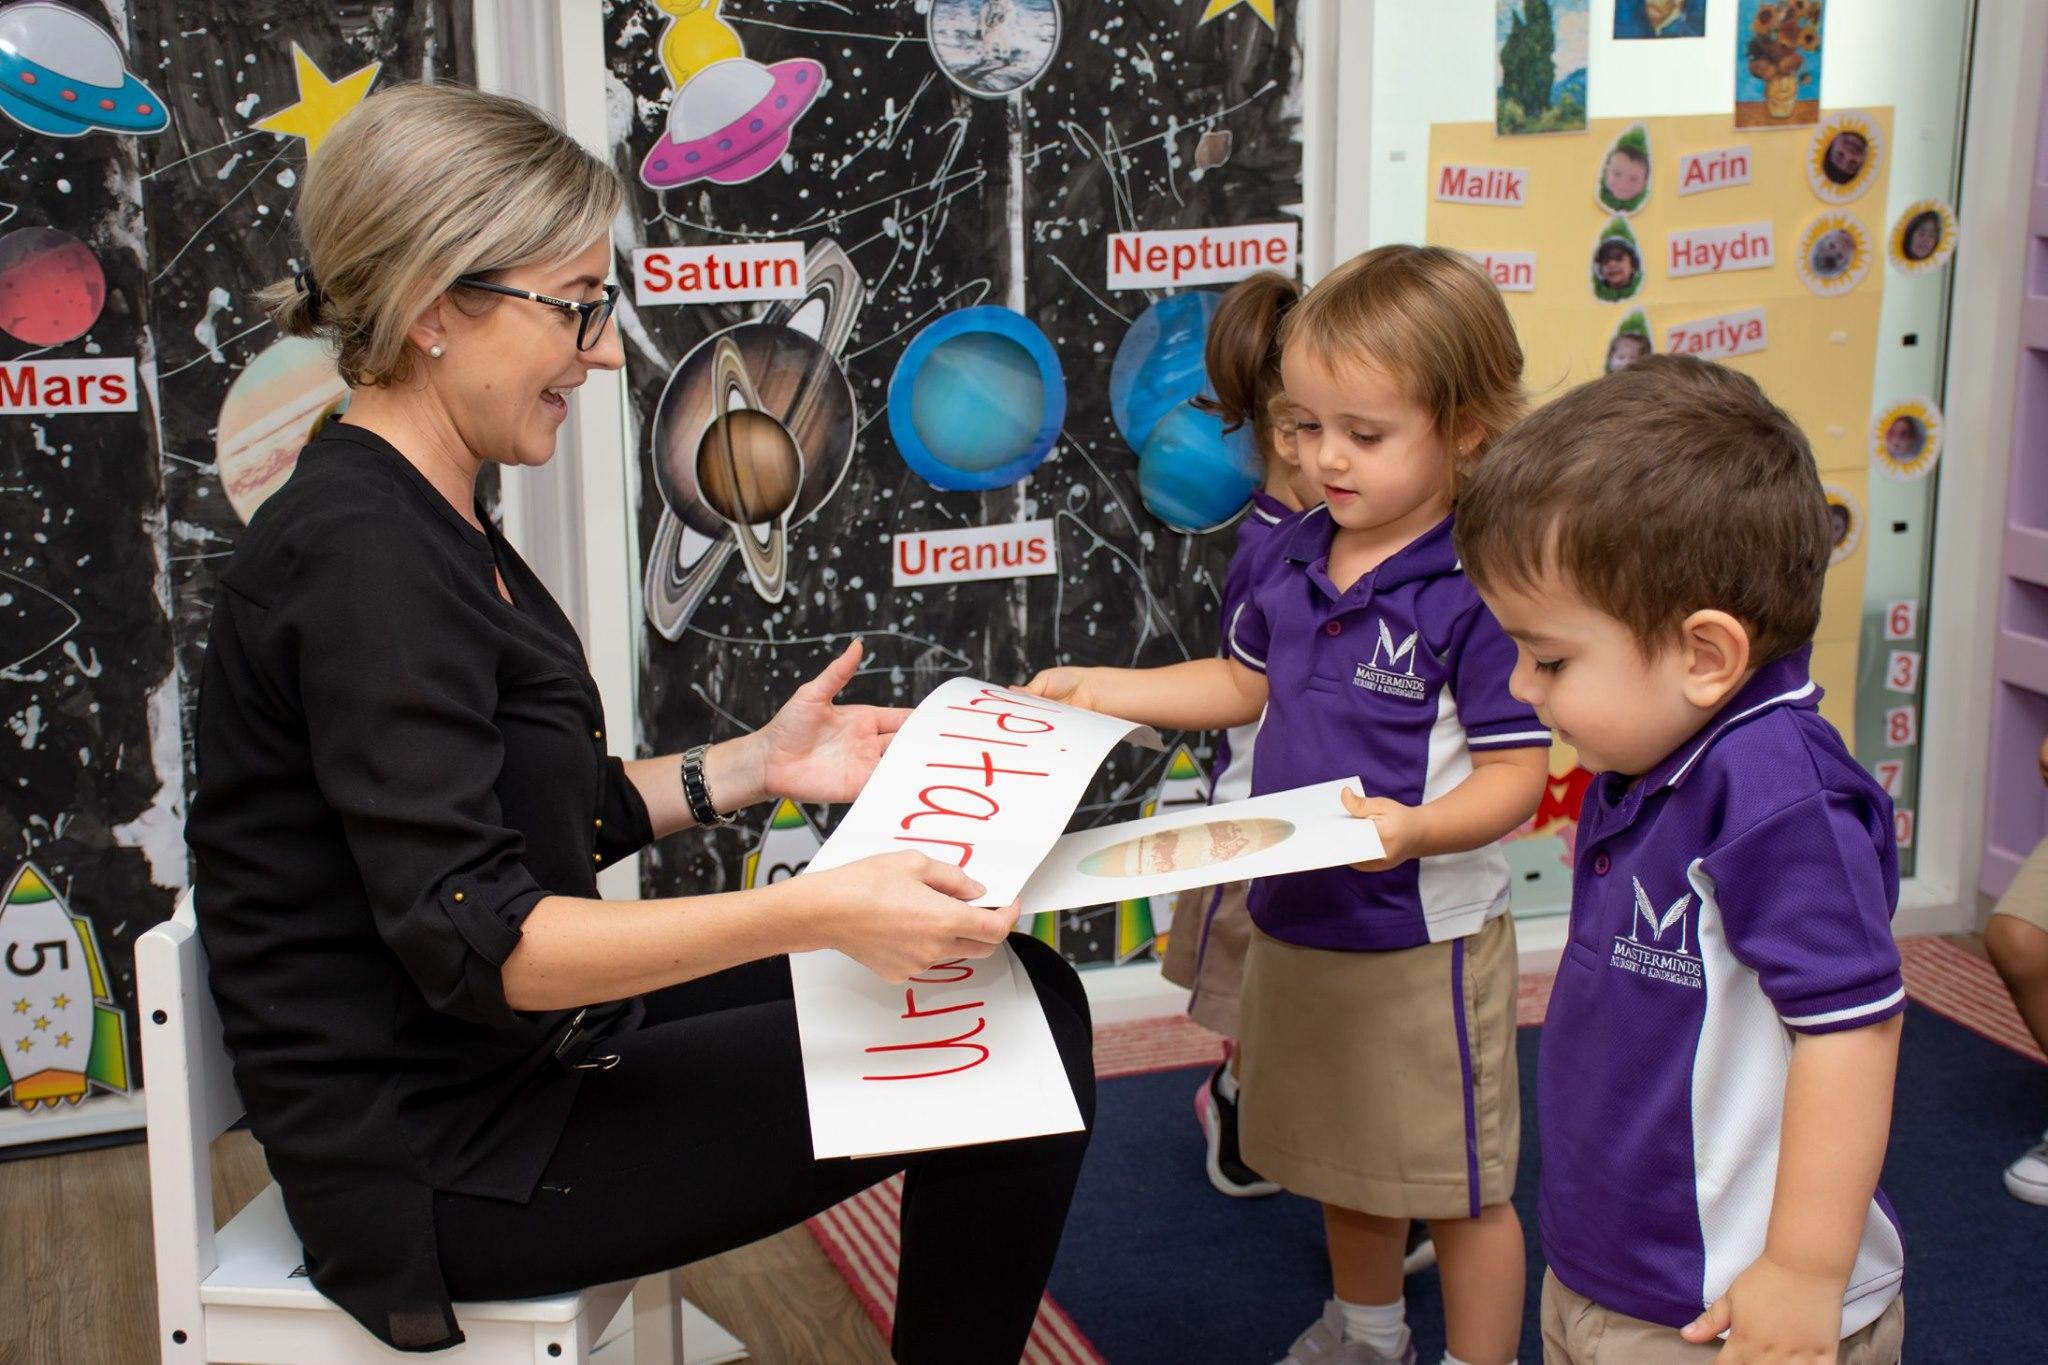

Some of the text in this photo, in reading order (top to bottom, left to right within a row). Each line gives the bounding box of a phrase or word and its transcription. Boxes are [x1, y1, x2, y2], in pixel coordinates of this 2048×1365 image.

[1440, 167, 1520, 200] Malik
[1684, 154, 1747, 188] Arin
[1113, 237, 1288, 279] Neptune
[1671, 231, 1769, 272] Haydn
[643, 252, 798, 293] Saturn
[1670, 319, 1763, 353] Zariya
[0, 366, 128, 407] Mars
[899, 538, 1047, 577] Uranus
[1890, 603, 1910, 635] 6
[1355, 666, 1425, 692] MASTERMINDS
[1893, 655, 1912, 688] 3
[1890, 712, 1910, 743] 8
[1879, 765, 1898, 792] 7
[5, 940, 69, 977] 5
[1613, 941, 1701, 977] MASTERMINDS
